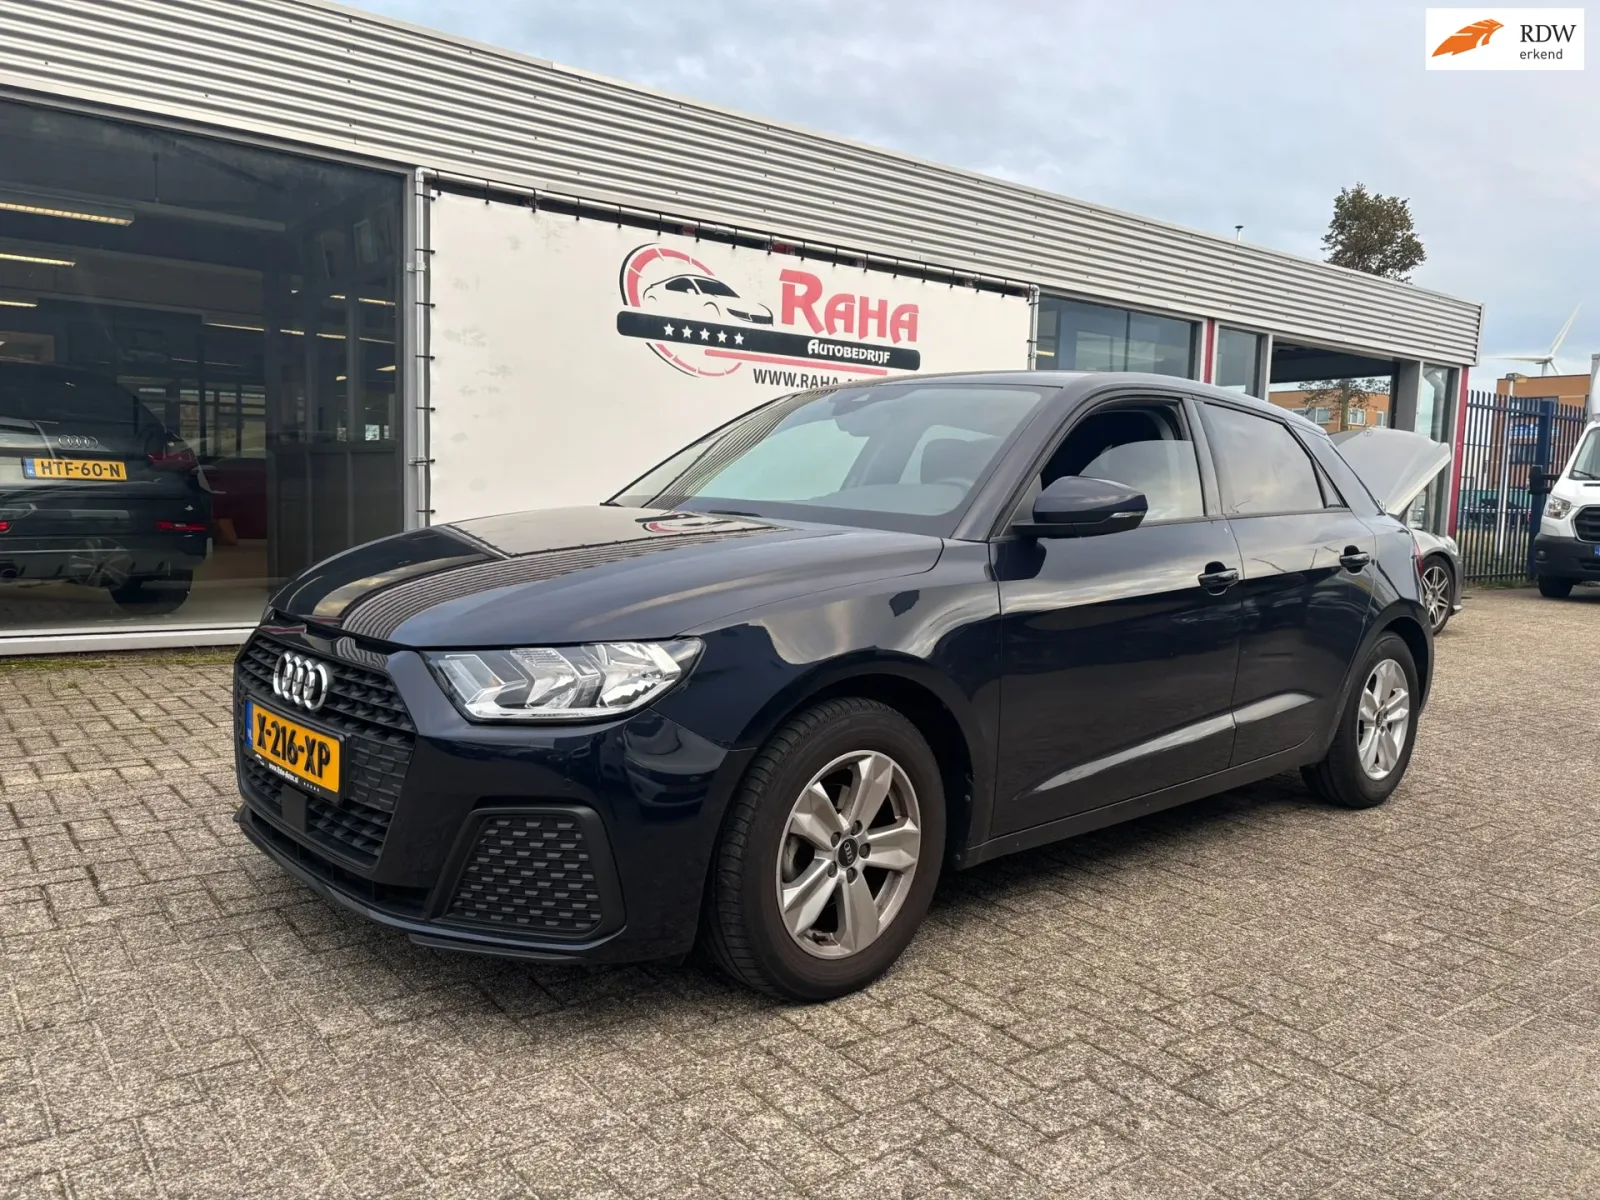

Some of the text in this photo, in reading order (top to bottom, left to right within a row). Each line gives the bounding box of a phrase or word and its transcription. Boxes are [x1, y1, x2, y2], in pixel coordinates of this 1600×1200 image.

[779, 268, 919, 344] RAHA
[753, 368, 859, 389] WWW.RAHA
[40, 460, 121, 478] HTF-60-N
[257, 712, 331, 779] X-216-XP
